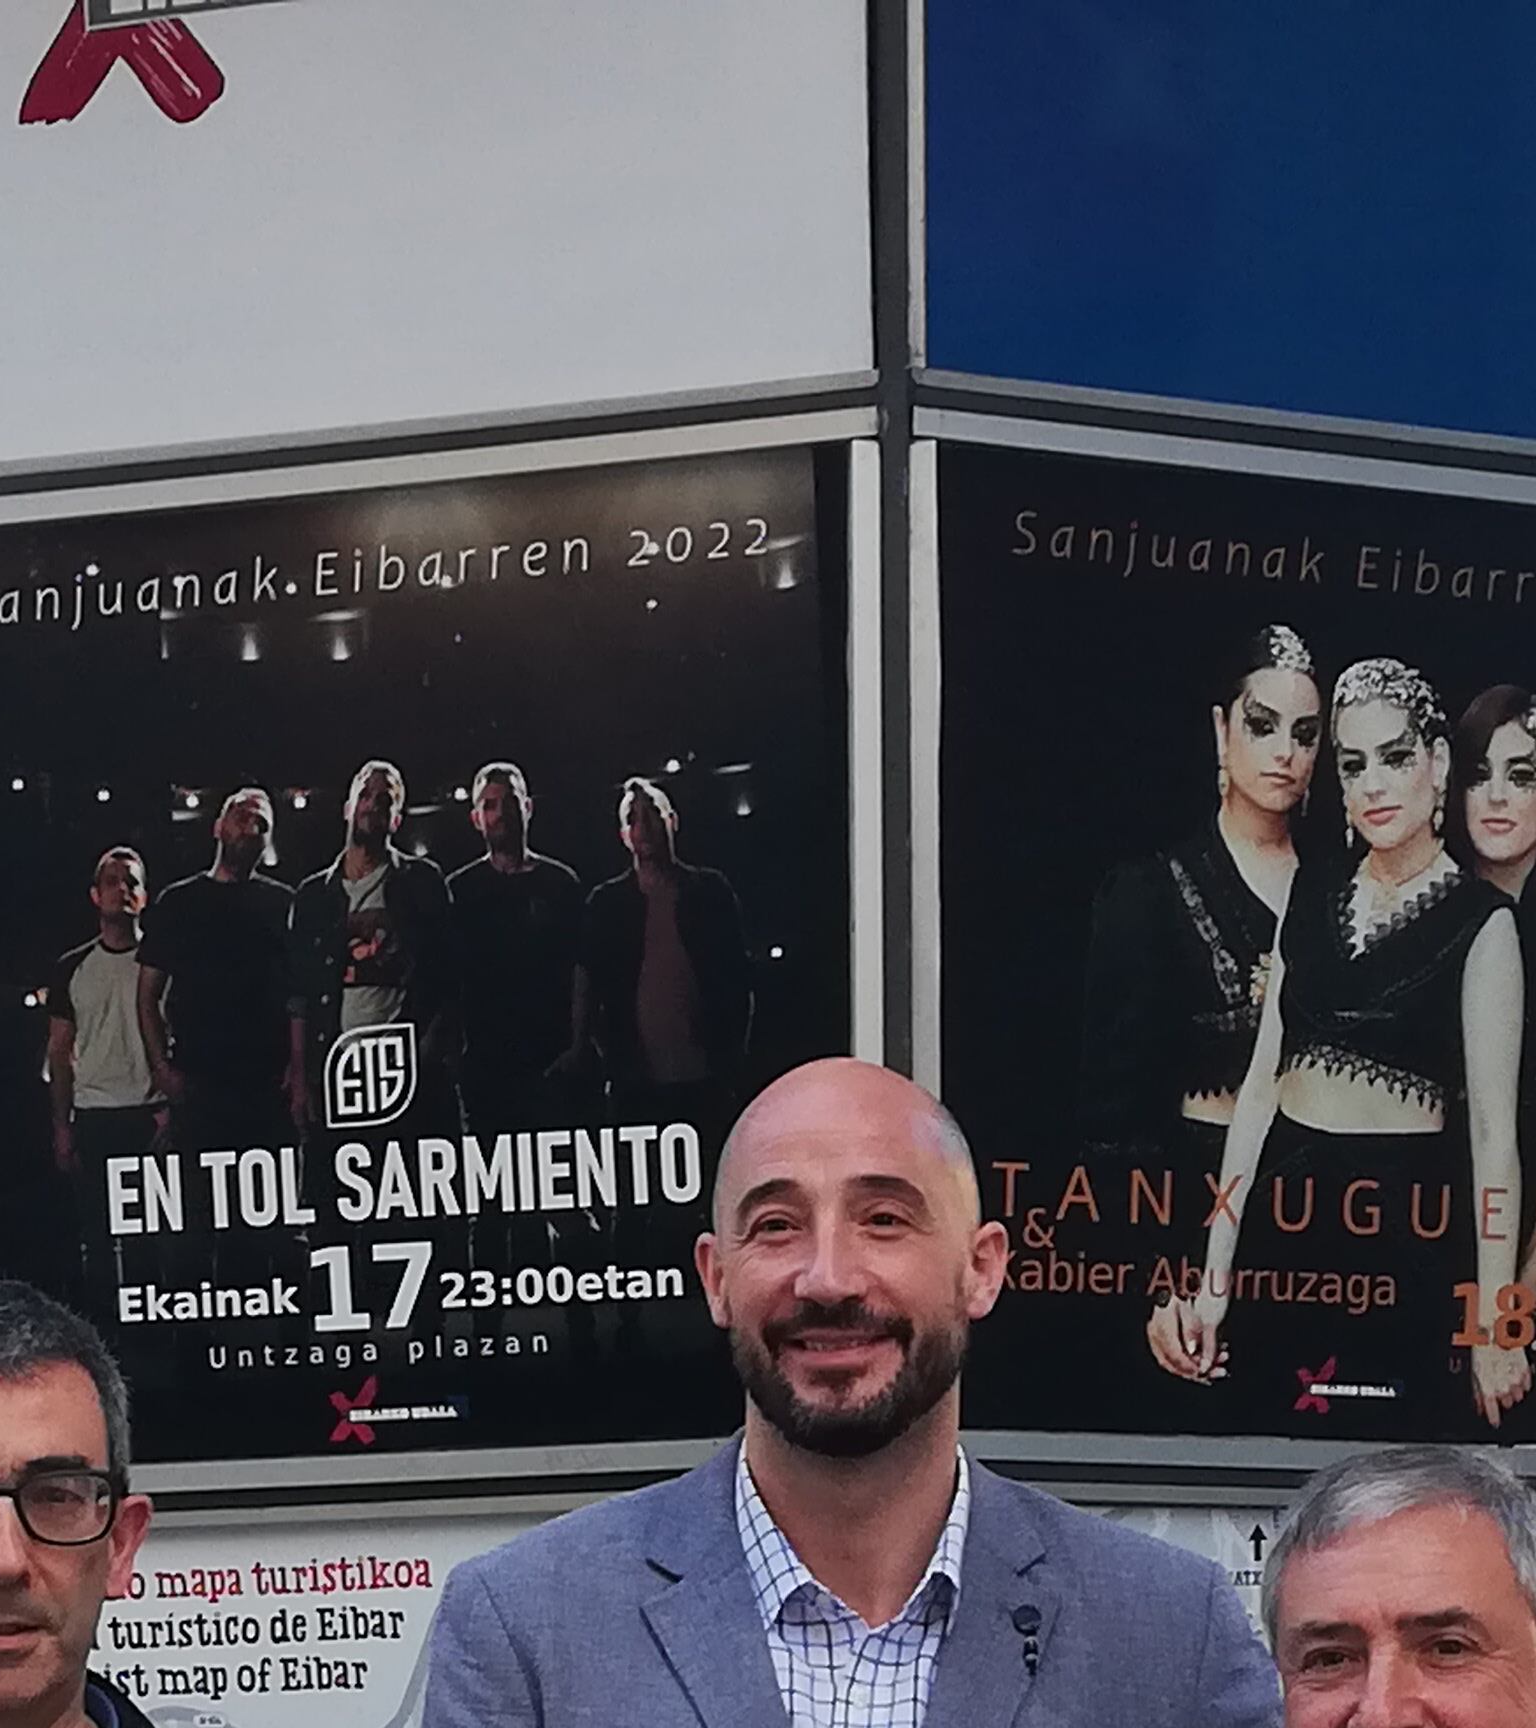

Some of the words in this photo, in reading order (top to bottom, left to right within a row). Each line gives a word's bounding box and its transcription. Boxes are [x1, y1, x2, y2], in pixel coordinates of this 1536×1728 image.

[314, 536, 591, 596] Eibarren
[627, 517, 770, 567] 2022
[1011, 510, 1326, 583] Sanjuanak
[335, 1036, 405, 1116] ETS
[106, 1154, 184, 1235] EN
[200, 1147, 316, 1230] TOL
[334, 1122, 702, 1221] SARMIENTO
[1022, 1207, 1055, 1249] &
[117, 1278, 301, 1324] Ekainak
[309, 1240, 434, 1333] 17
[439, 1266, 684, 1310] 23:00etan
[1146, 1254, 1396, 1315] Aburruzaga
[208, 1342, 378, 1370] Untzaga
[408, 1332, 550, 1365] plazan
[154, 1568, 244, 1603] mapa
[251, 1556, 433, 1595] turistikoa
[107, 1611, 261, 1651] turístico
[269, 1608, 308, 1644] de
[315, 1605, 405, 1641] Eibar
[156, 1664, 228, 1701] map
[236, 1657, 273, 1694] of
[279, 1656, 369, 1692] Eibar
